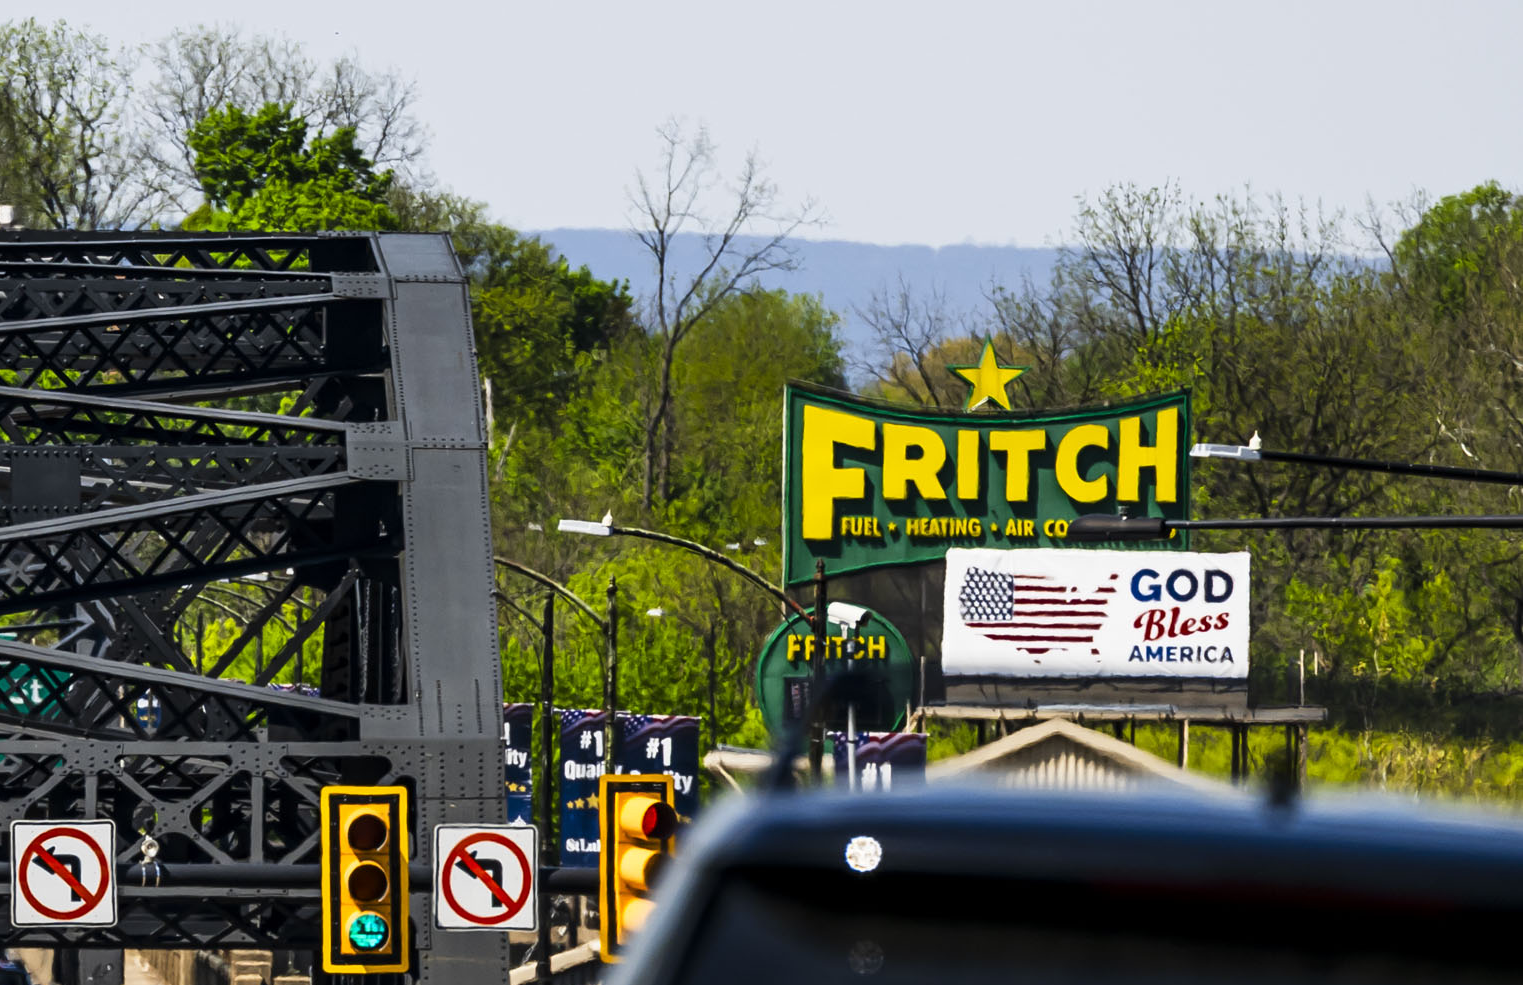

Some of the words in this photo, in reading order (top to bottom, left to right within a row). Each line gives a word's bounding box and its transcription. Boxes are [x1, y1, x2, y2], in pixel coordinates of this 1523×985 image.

[802, 405, 1178, 540] FRITCH
[840, 517, 882, 538] FUEL
[905, 517, 982, 538] HEATING
[1005, 518, 1035, 537] AIR
[1130, 568, 1234, 603] GOD
[1133, 606, 1230, 642] Bless
[1128, 645, 1235, 663] AMERICA
[580, 730, 604, 757] #1
[645, 737, 672, 767] #1
